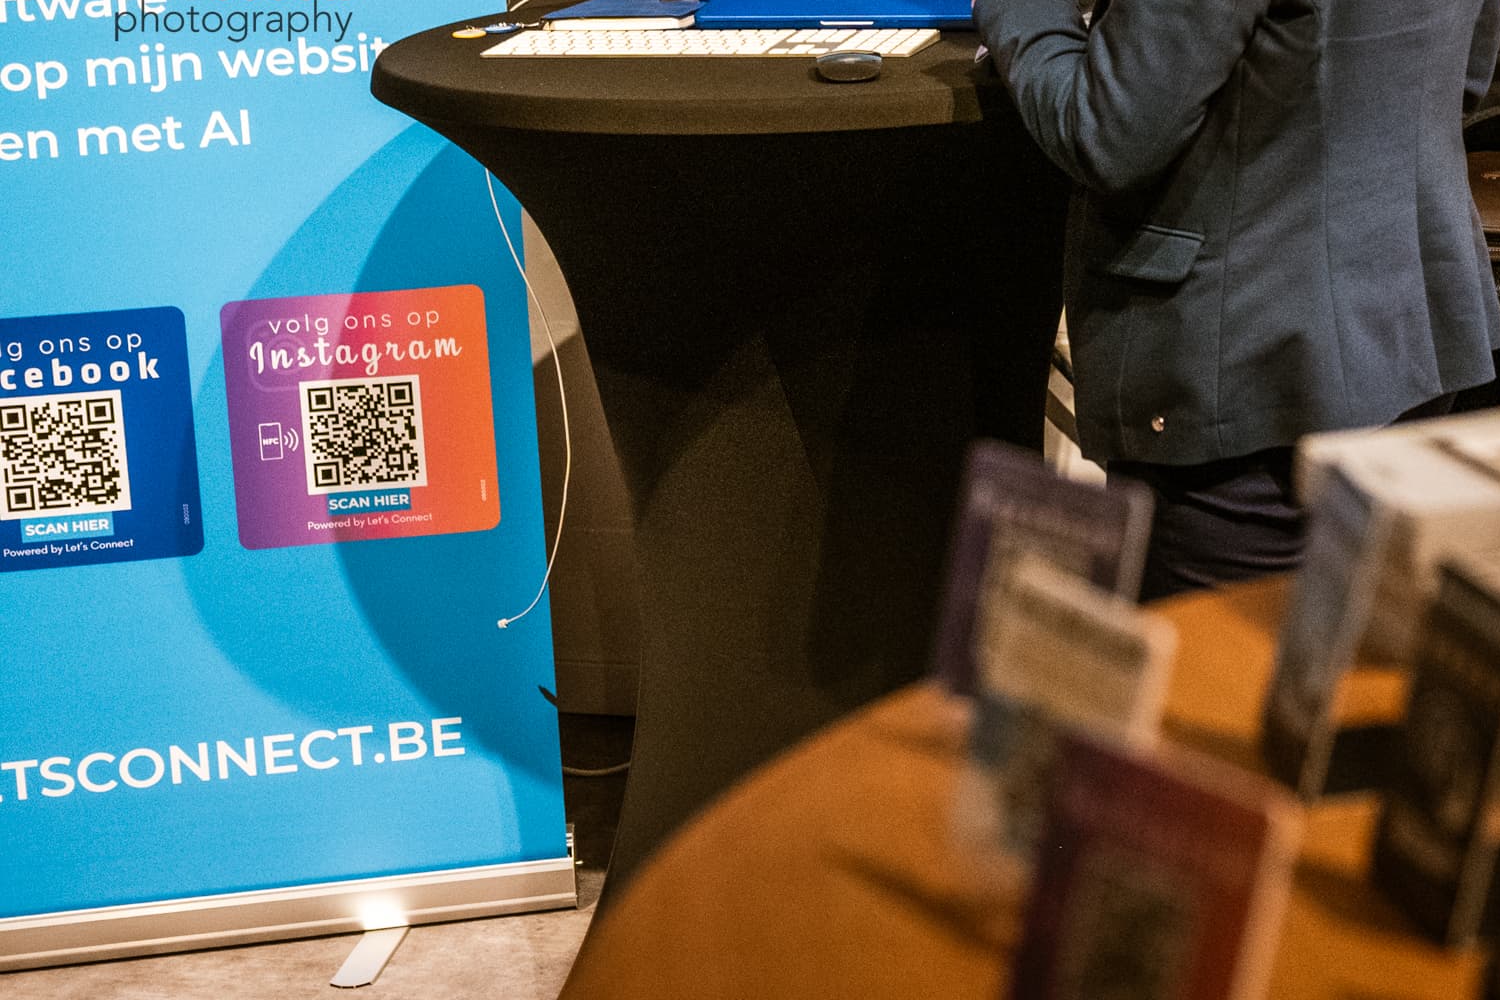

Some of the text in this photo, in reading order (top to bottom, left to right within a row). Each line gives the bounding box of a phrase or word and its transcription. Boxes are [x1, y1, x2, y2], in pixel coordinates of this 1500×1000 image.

[0, 32, 390, 99] op mijn websit
[0, 109, 252, 161] en met AI
[268, 310, 440, 336] volg ons op
[39, 336, 91, 355] ons
[106, 333, 142, 352] op
[249, 336, 462, 375] Instagram
[0, 352, 160, 391] cebook
[329, 494, 410, 511] SCAN HIER
[25, 518, 110, 537] SCAN HIER
[307, 513, 433, 531] Powered by Let's Connect
[3, 538, 134, 558] Powered by Let's Connect
[0, 716, 467, 801] TSCONNECT.BE
